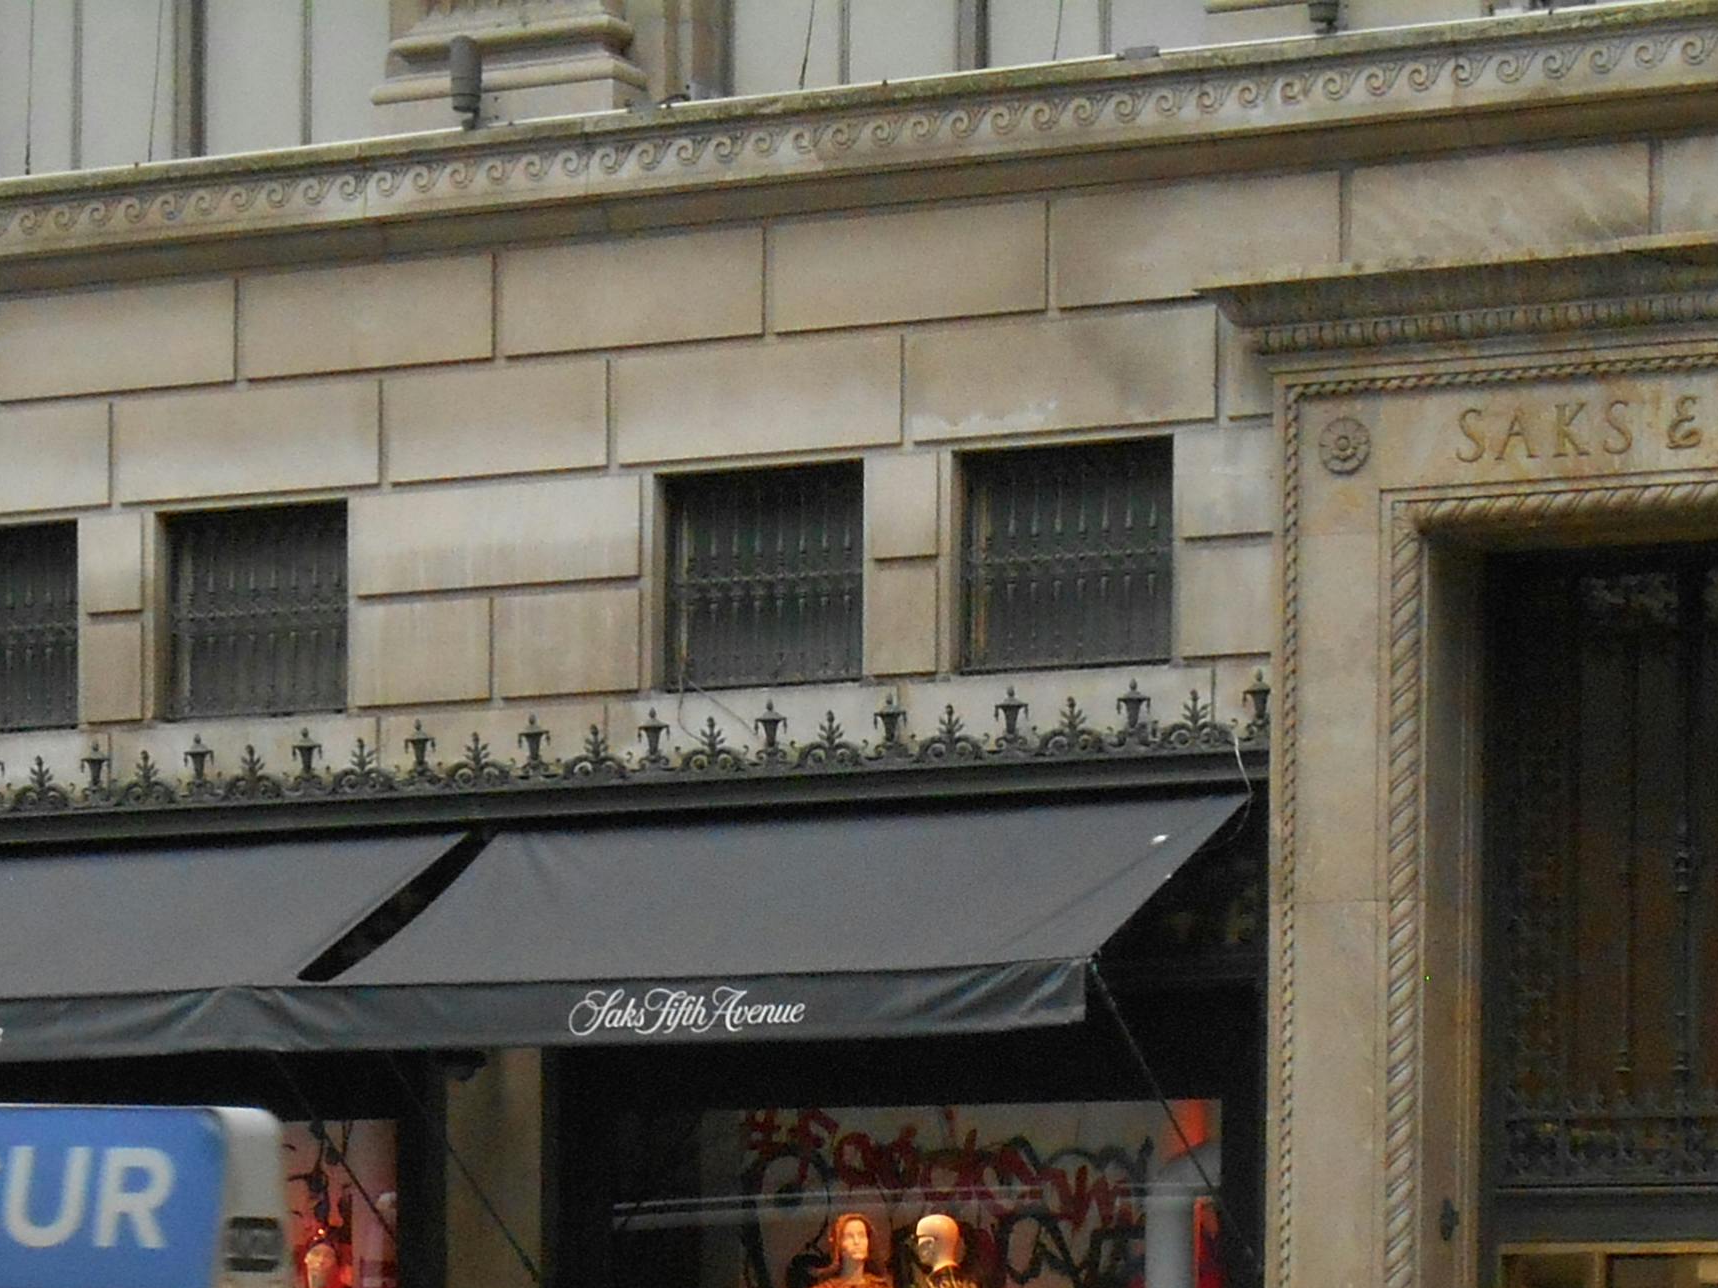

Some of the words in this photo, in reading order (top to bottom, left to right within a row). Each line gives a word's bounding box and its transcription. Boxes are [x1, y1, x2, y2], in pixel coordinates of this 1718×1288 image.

[1455, 400, 1632, 463] SAKS
[1665, 396, 1701, 450] &
[568, 989, 645, 1036] Saks
[634, 987, 707, 1034] Fifth
[691, 986, 806, 1033] Avenue
